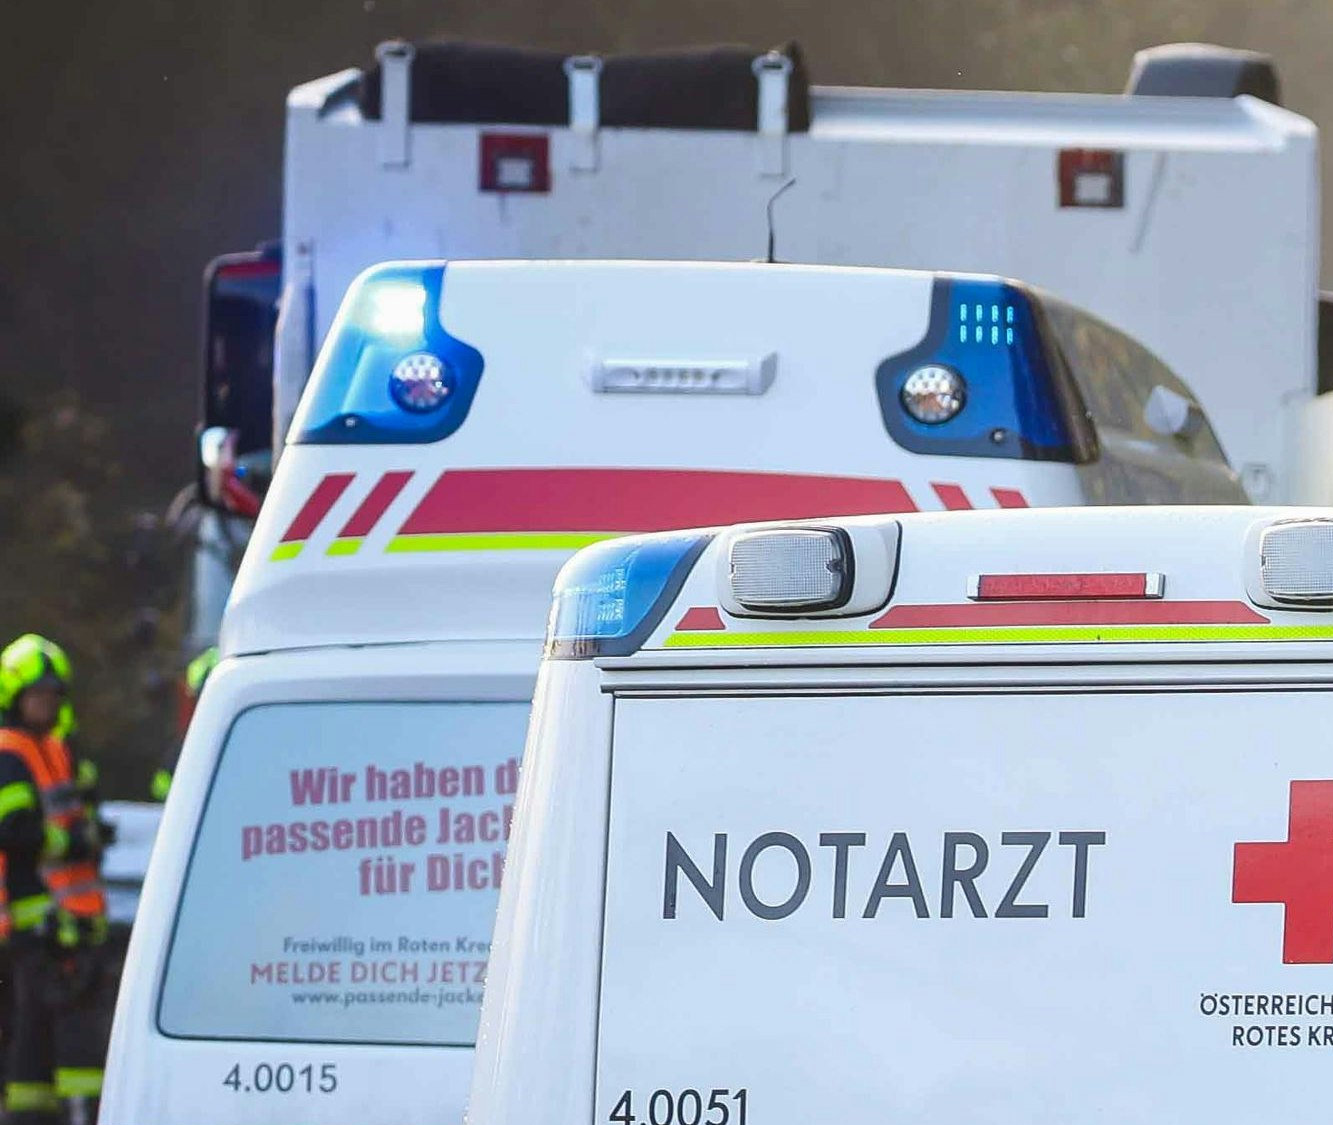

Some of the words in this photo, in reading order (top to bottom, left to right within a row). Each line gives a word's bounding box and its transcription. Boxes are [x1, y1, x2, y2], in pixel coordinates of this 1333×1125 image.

[290, 767, 356, 806] Wir
[366, 761, 484, 802] haben
[495, 756, 522, 795] d
[241, 810, 426, 860] passende
[359, 856, 415, 895] für
[661, 830, 1106, 923] NOTARZT
[283, 936, 364, 955] Freiwillig
[371, 936, 392, 952] im
[398, 936, 450, 953] Roten
[455, 936, 492, 953] Kre
[250, 961, 341, 984] MELDE
[351, 961, 419, 983] DICH
[1232, 1025, 1301, 1047] ROTES
[222, 1061, 338, 1093] 4.0015
